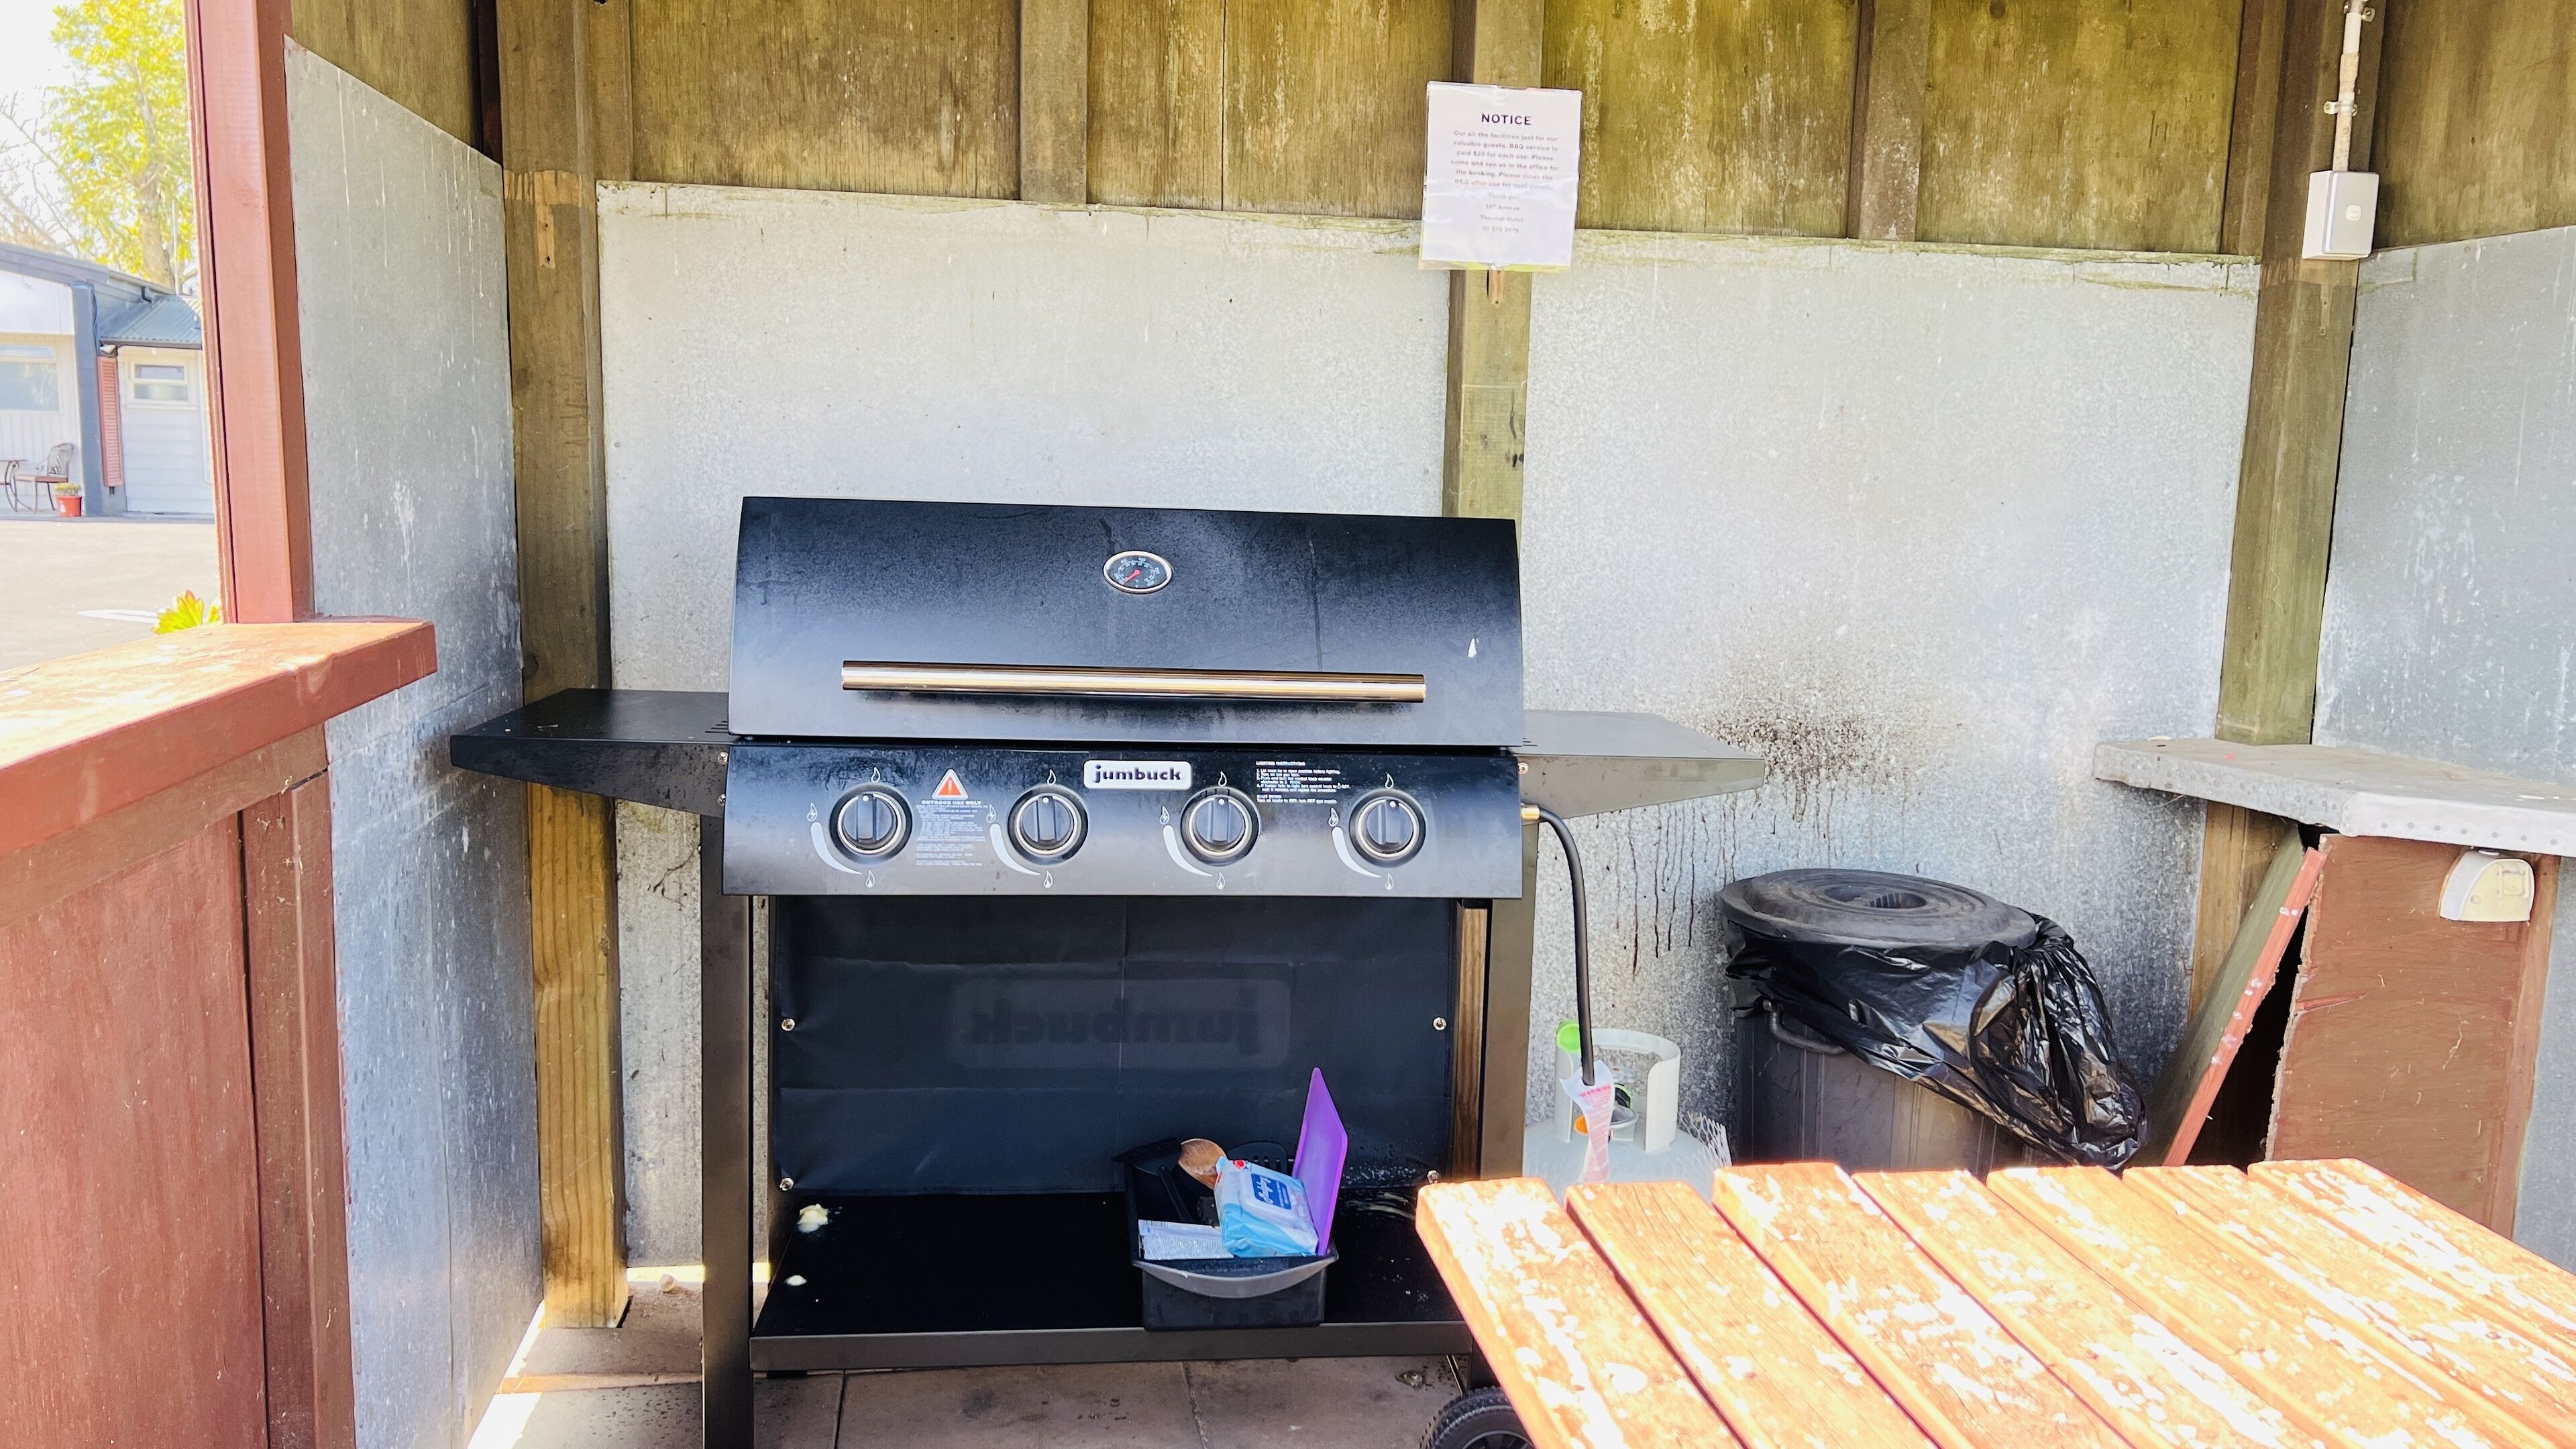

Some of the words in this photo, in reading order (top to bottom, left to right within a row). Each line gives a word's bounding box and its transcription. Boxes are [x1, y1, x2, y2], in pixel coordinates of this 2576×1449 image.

[1481, 113, 1532, 125] NOTICE
[1095, 764, 1181, 783] jumbuck
[1580, 1084, 1611, 1097] WARNING
